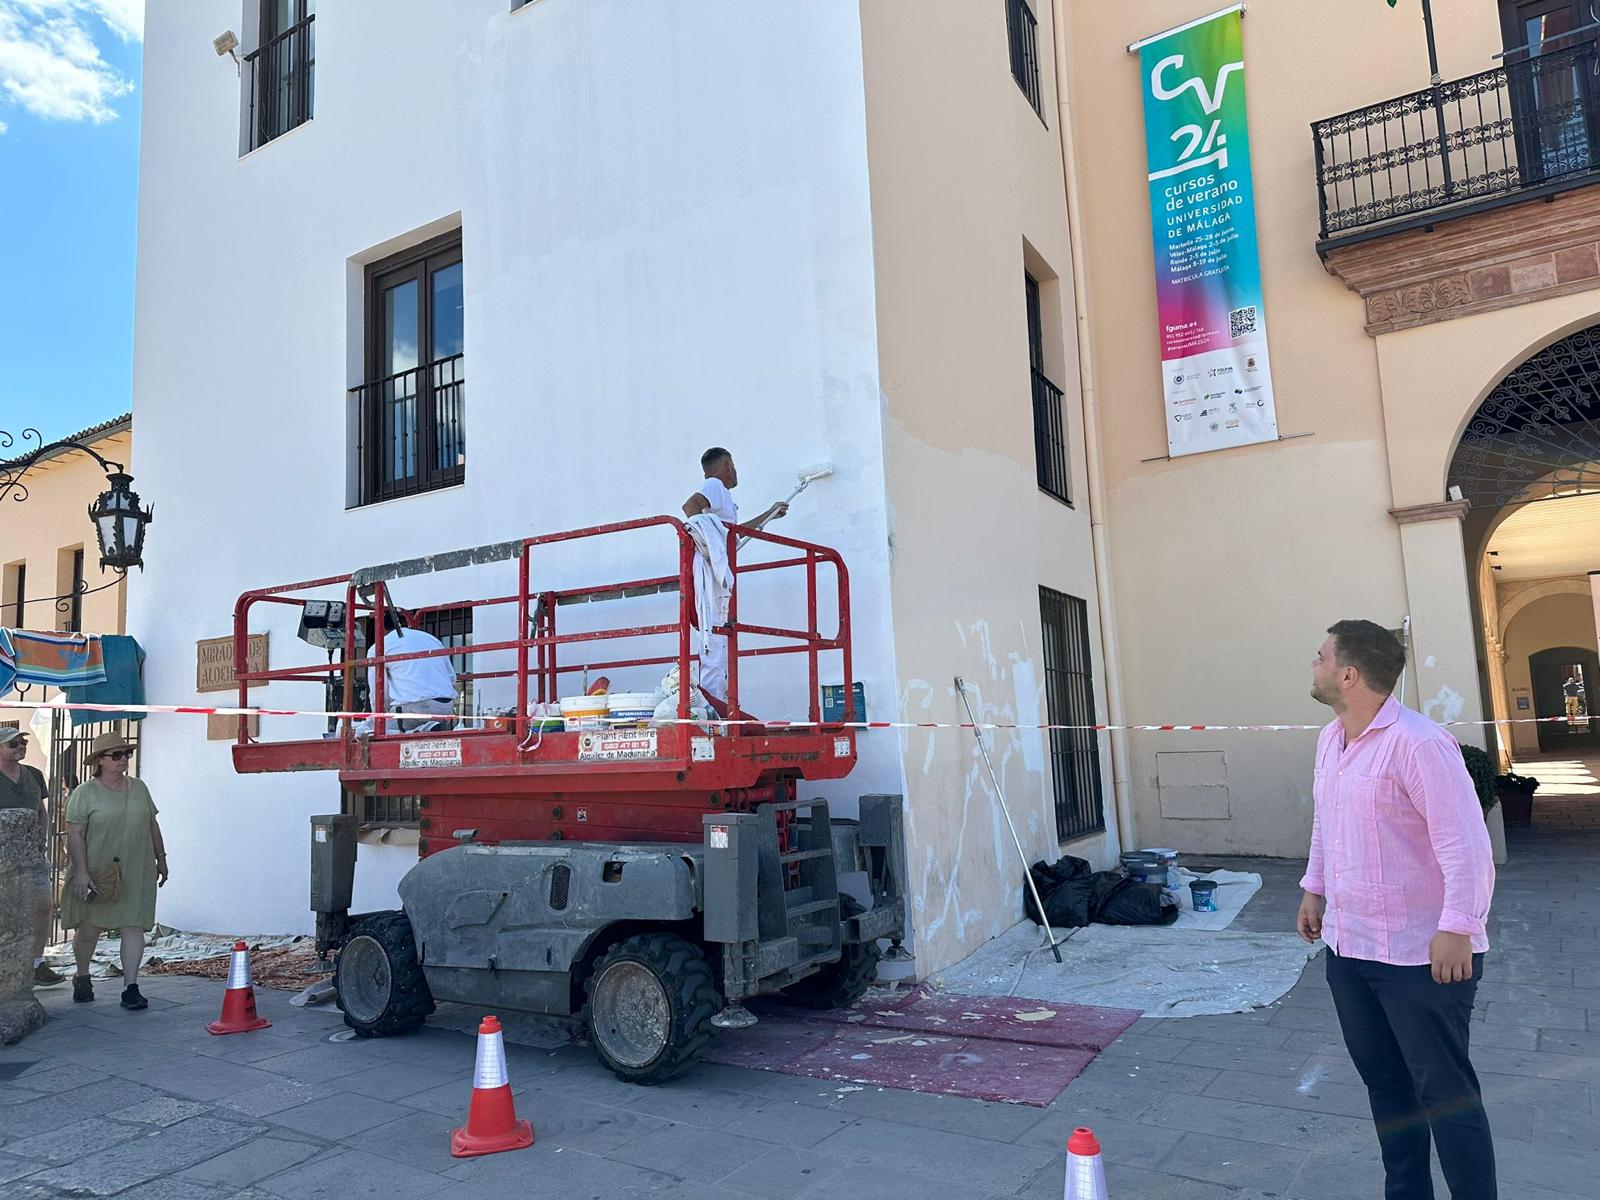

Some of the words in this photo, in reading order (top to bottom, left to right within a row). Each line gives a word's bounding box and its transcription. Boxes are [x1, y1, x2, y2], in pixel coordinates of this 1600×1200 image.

[1151, 54, 1244, 115] CV
[1168, 119, 1228, 171] 24
[1165, 174, 1215, 198] cursos
[1166, 197, 1184, 211] de
[1187, 180, 1238, 205] verano
[1167, 195, 1243, 226] UNIVERSIDAD
[1168, 228, 1182, 238] DE
[1187, 212, 1231, 233] MÁLAGA
[1169, 240, 1193, 250] Marbella
[1194, 234, 1213, 243] 25-28
[1170, 257, 1188, 265] Ronda
[1189, 252, 1199, 261] 2-5
[1171, 264, 1191, 272] Málaga
[1166, 321, 1197, 332] fguma.es
[201, 642, 238, 663] MIRAD
[597, 732, 616, 741] Plant
[619, 731, 637, 739] Rent
[639, 730, 655, 738] Hire
[580, 751, 605, 760] Alquiler
